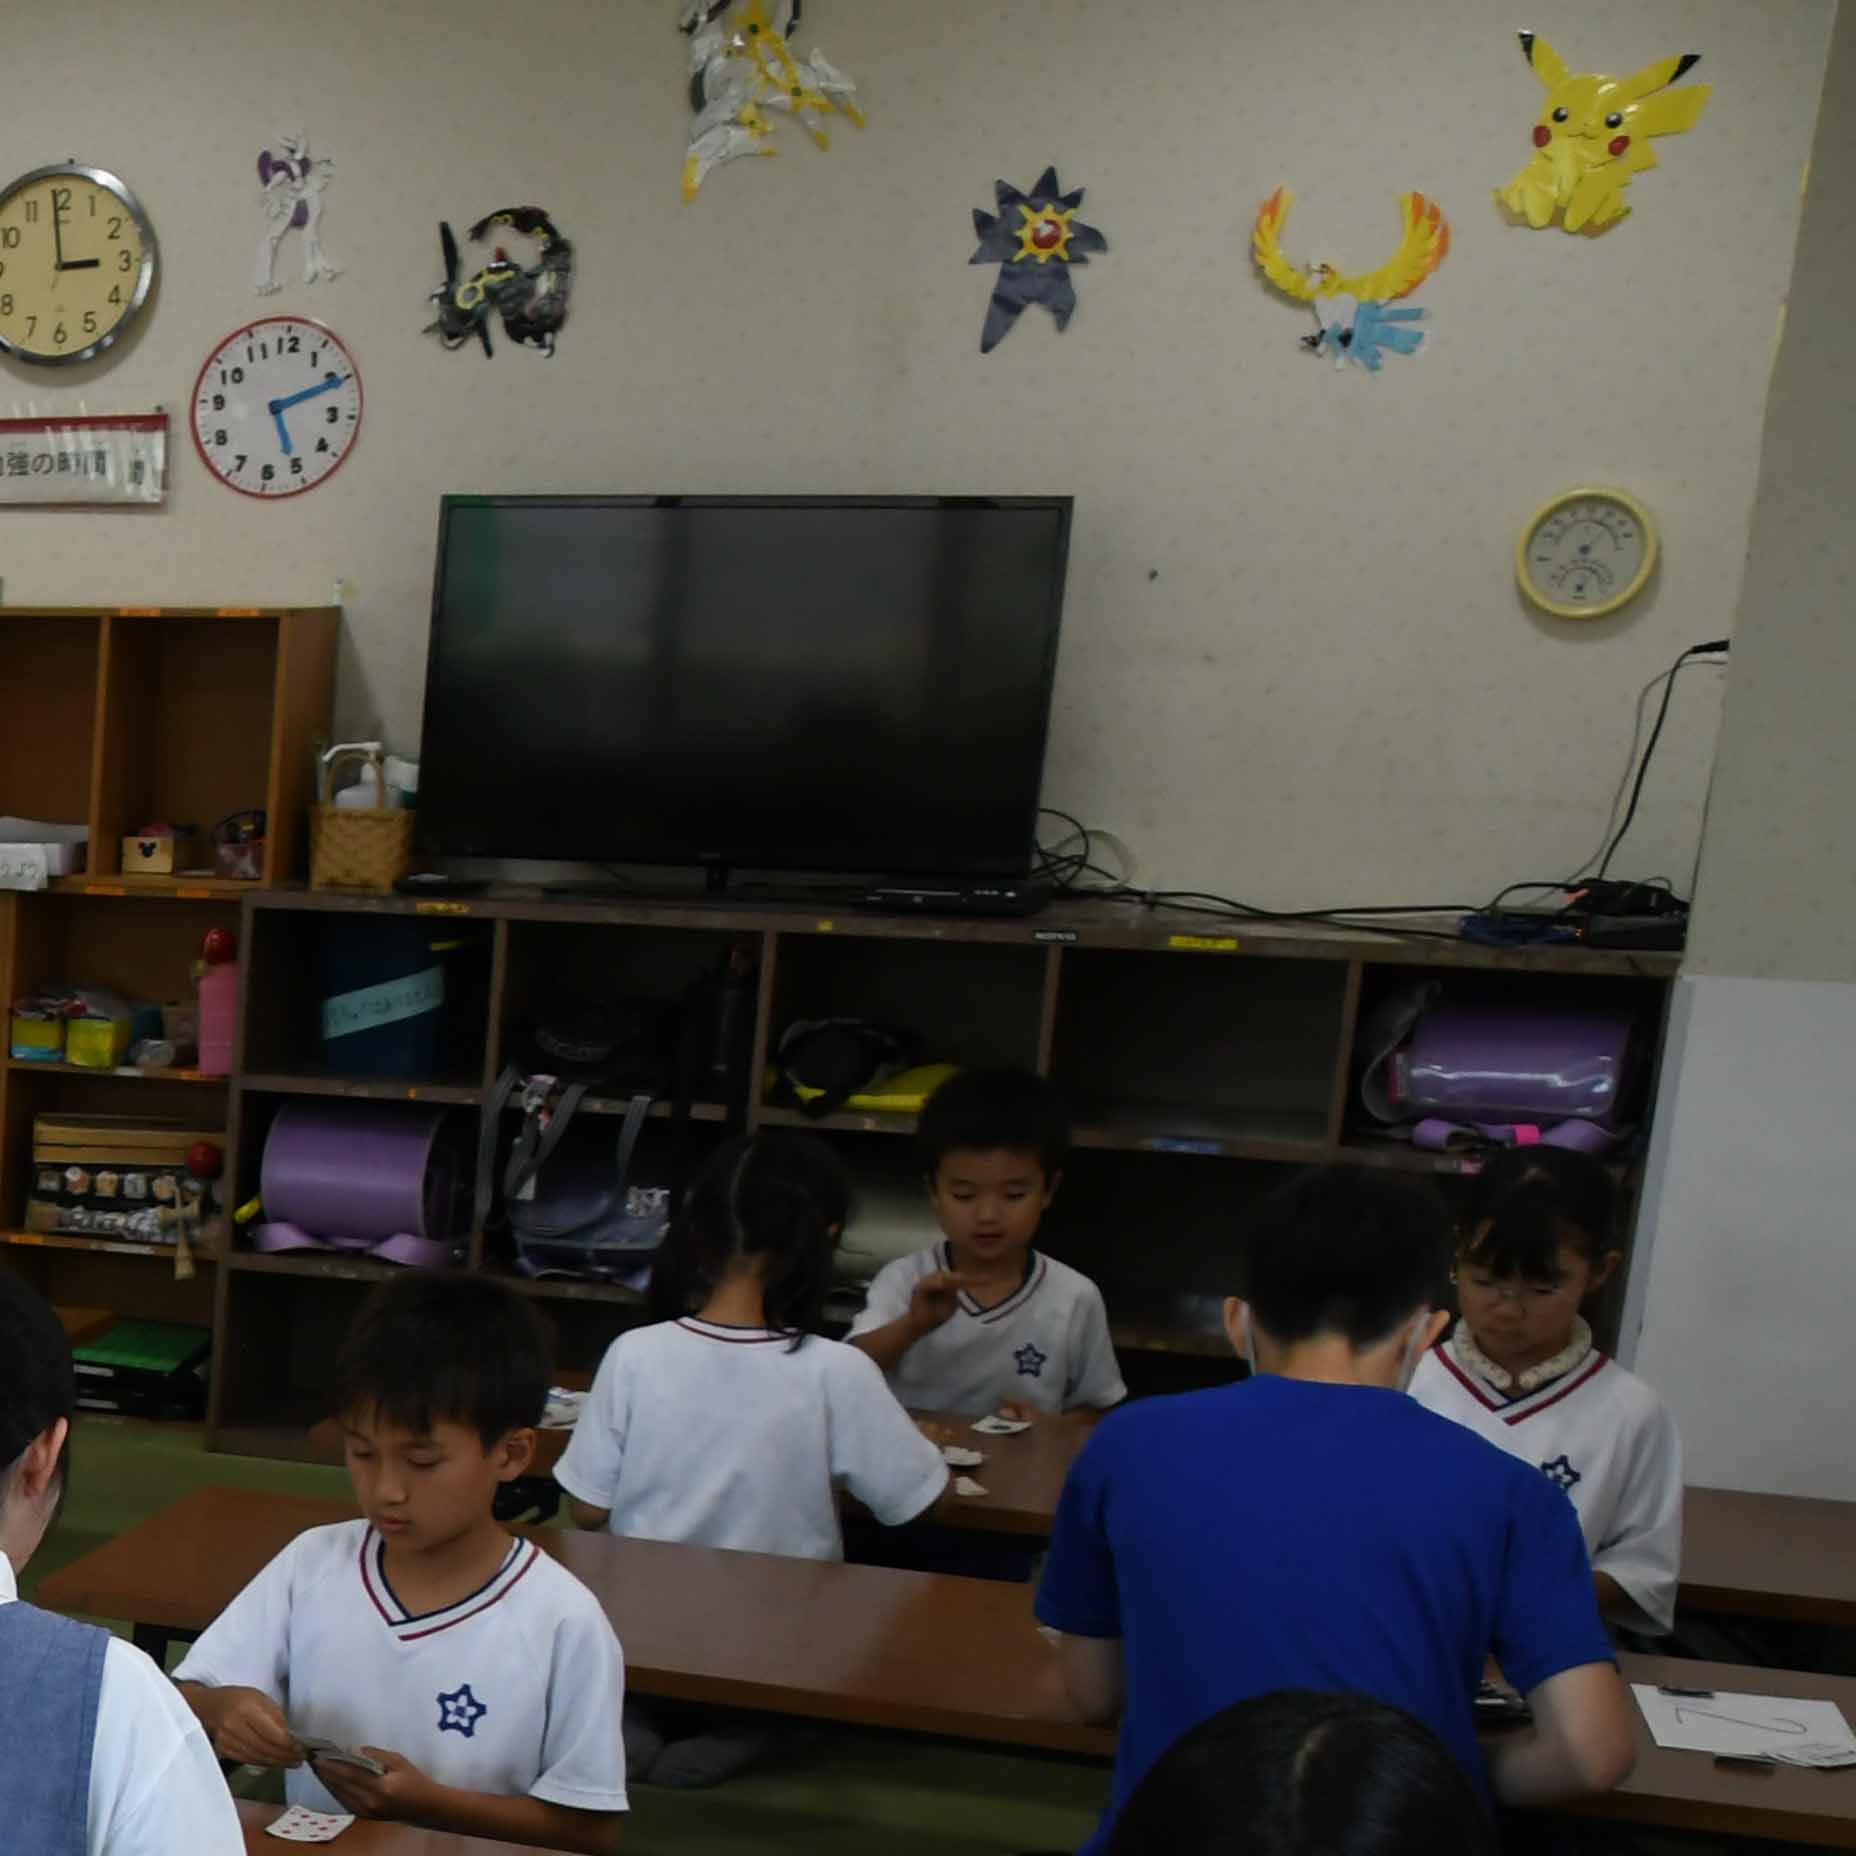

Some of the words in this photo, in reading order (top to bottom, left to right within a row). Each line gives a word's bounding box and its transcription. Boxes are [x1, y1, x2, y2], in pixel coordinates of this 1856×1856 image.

[52, 188, 72, 211] 2
[89, 195, 96, 217] 1
[24, 200, 38, 222] 11
[1, 226, 21, 249] 10
[107, 217, 121, 240] 2
[118, 250, 131, 272] 3
[107, 284, 121, 304] 4
[0, 294, 14, 316] 8
[24, 315, 38, 337] 7
[82, 311, 97, 333] 5
[53, 321, 68, 344] 6
[247, 342, 268, 363] 11
[277, 336, 300, 355] 12
[310, 351, 318, 368] 1
[221, 367, 244, 386] 10
[213, 394, 225, 411] 9
[326, 406, 338, 423] 3
[215, 430, 228, 446] 8
[315, 437, 329, 453] 4
[235, 455, 248, 472] 7
[261, 464, 275, 480] 6
[290, 457, 303, 474] 5
